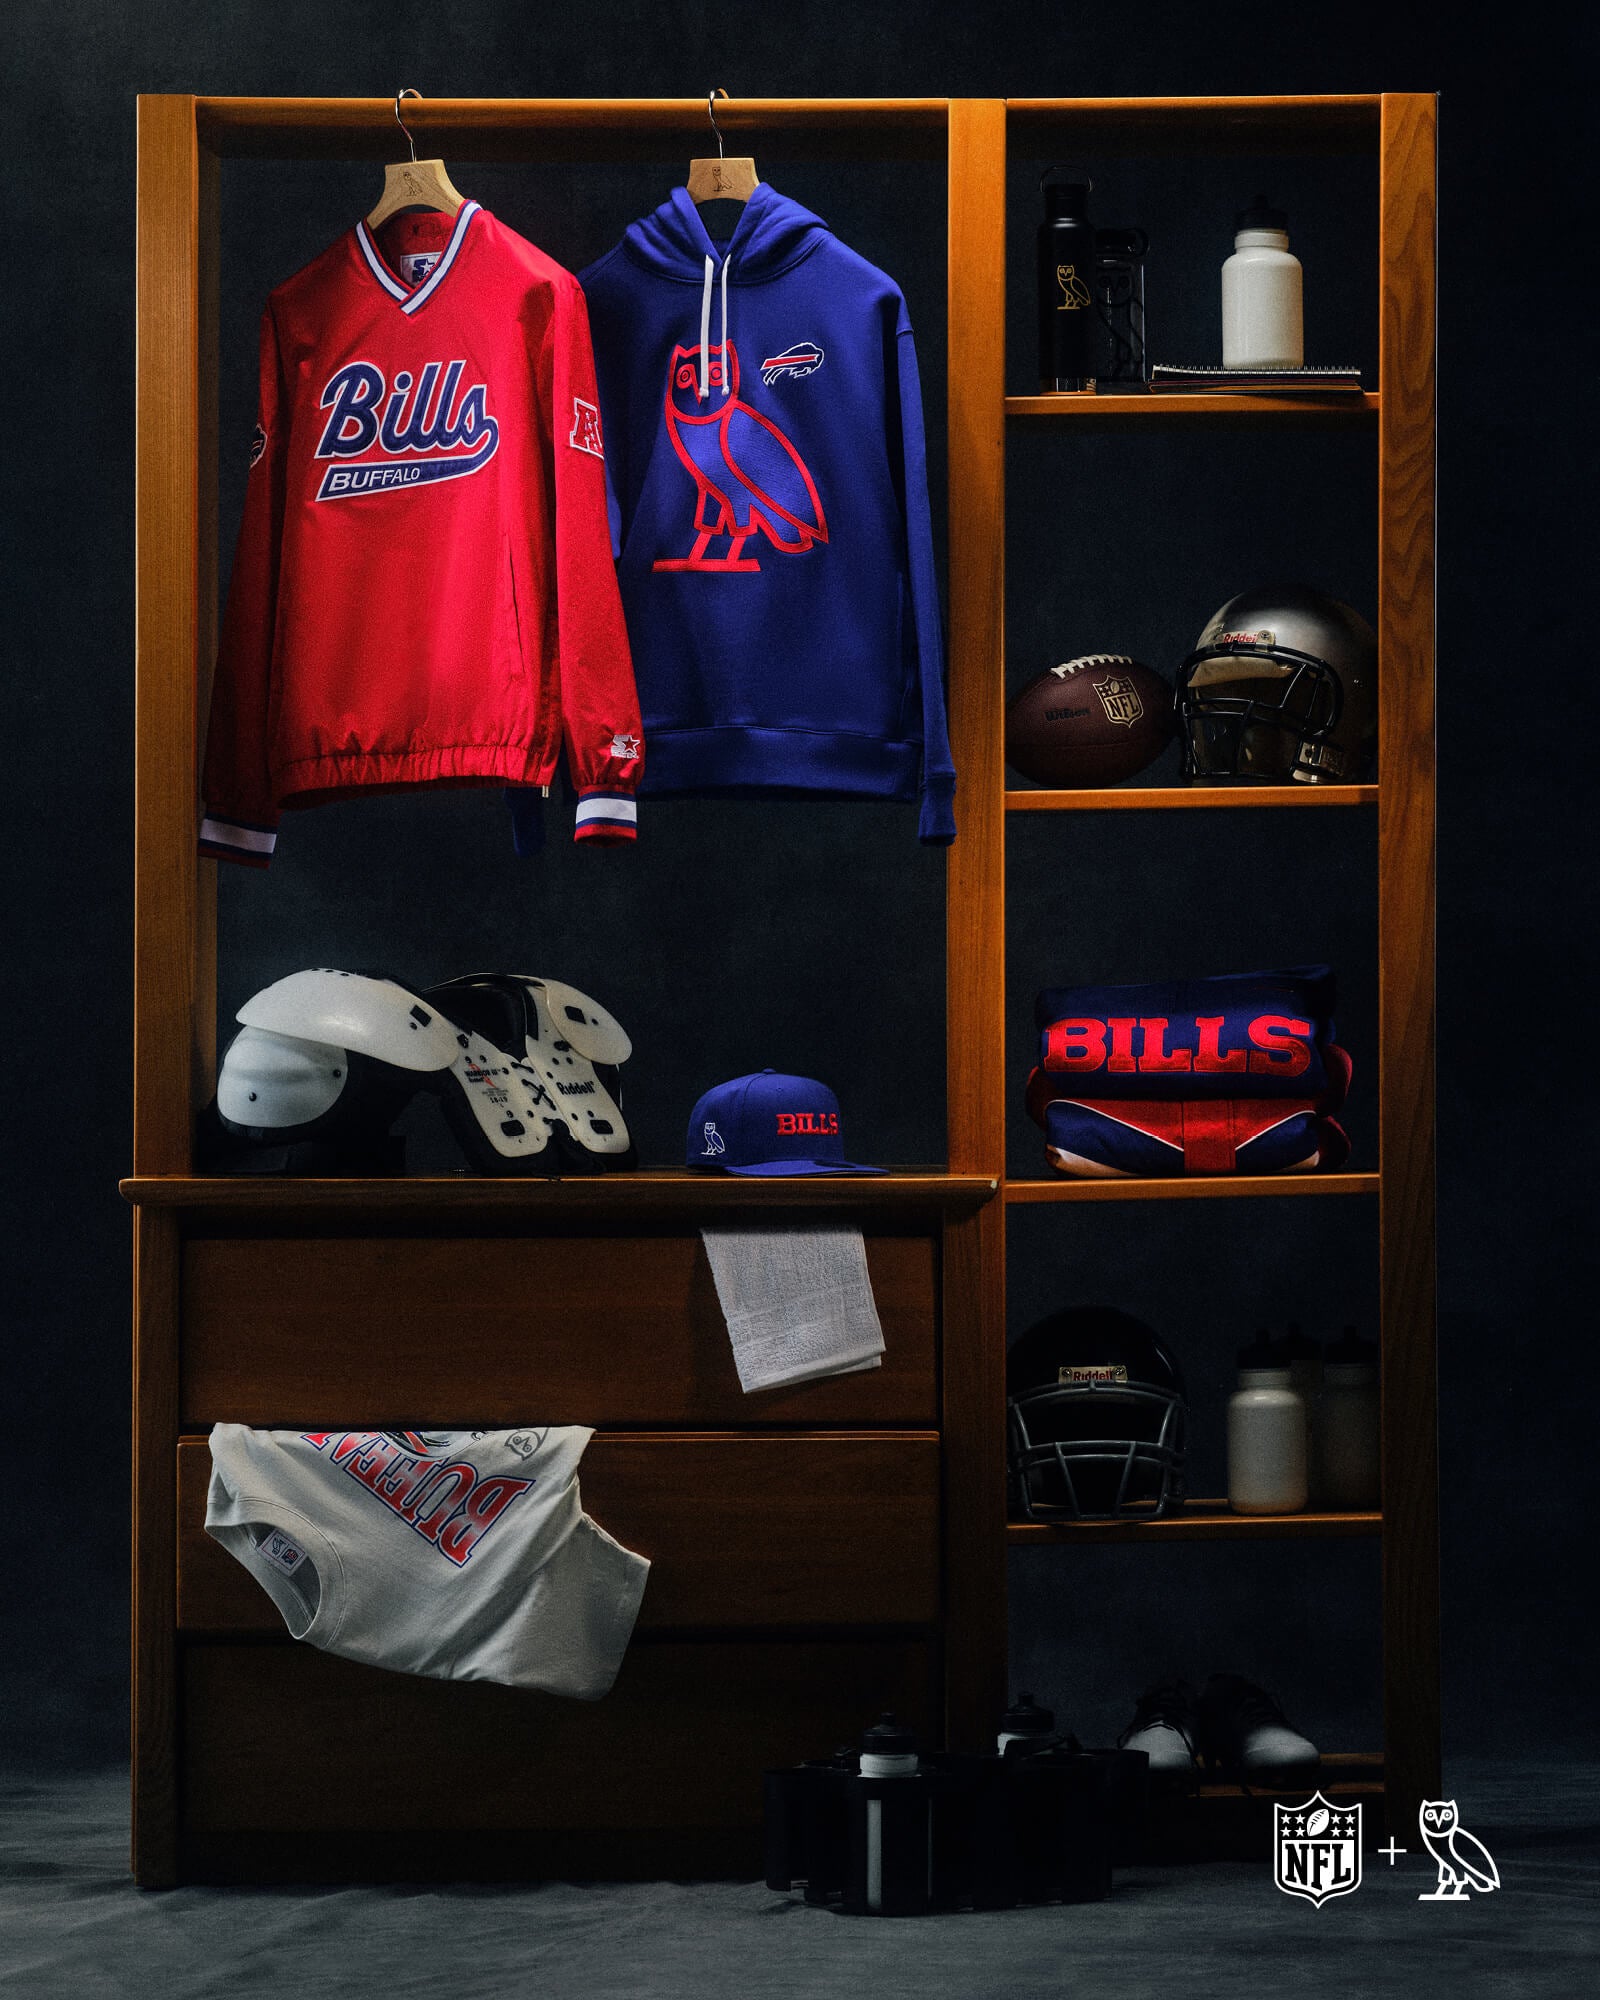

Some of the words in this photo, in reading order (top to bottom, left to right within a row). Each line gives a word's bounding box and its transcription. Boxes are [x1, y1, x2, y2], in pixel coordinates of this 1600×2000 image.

[314, 360, 500, 459] Bills
[327, 467, 421, 492] BUFFALO
[1044, 708, 1091, 721] Wilson
[1107, 693, 1140, 718] NFL
[1044, 1015, 1310, 1077] BILLS
[556, 1081, 595, 1095] Riddell
[776, 1113, 839, 1135] BILLS
[1073, 1369, 1113, 1381] Riddell
